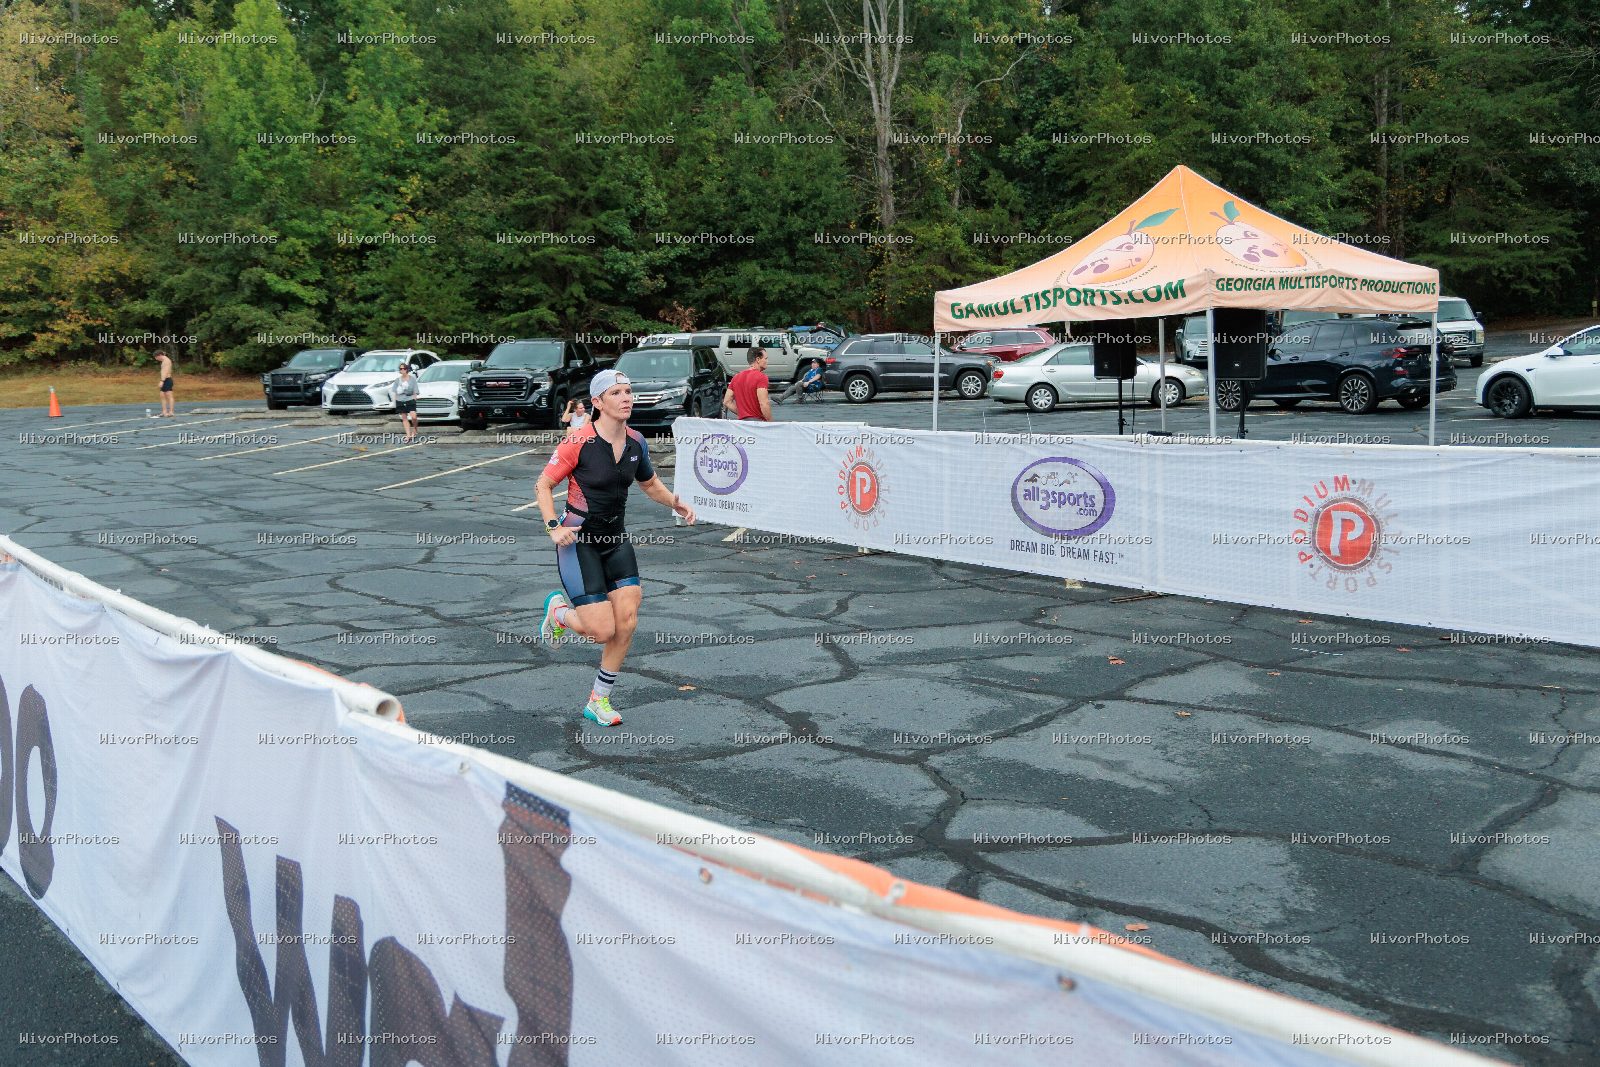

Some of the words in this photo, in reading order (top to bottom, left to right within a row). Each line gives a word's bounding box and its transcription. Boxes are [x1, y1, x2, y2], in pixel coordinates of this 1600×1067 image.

[1215, 276, 1276, 292] GEORGIA
[1278, 274, 1358, 291] MULTISPORTS
[1360, 278, 1437, 295] PRODUCTIONS
[950, 278, 1187, 320] GAMULTISPORTS.COM
[700, 454, 738, 474] all3sports
[1022, 485, 1096, 511] all3sports
[1076, 507, 1098, 517] .com
[1292, 474, 1351, 564] PODIUM
[1010, 539, 1038, 554] DREAM
[1040, 543, 1057, 557] BIG.
[1060, 545, 1090, 561] DREAM
